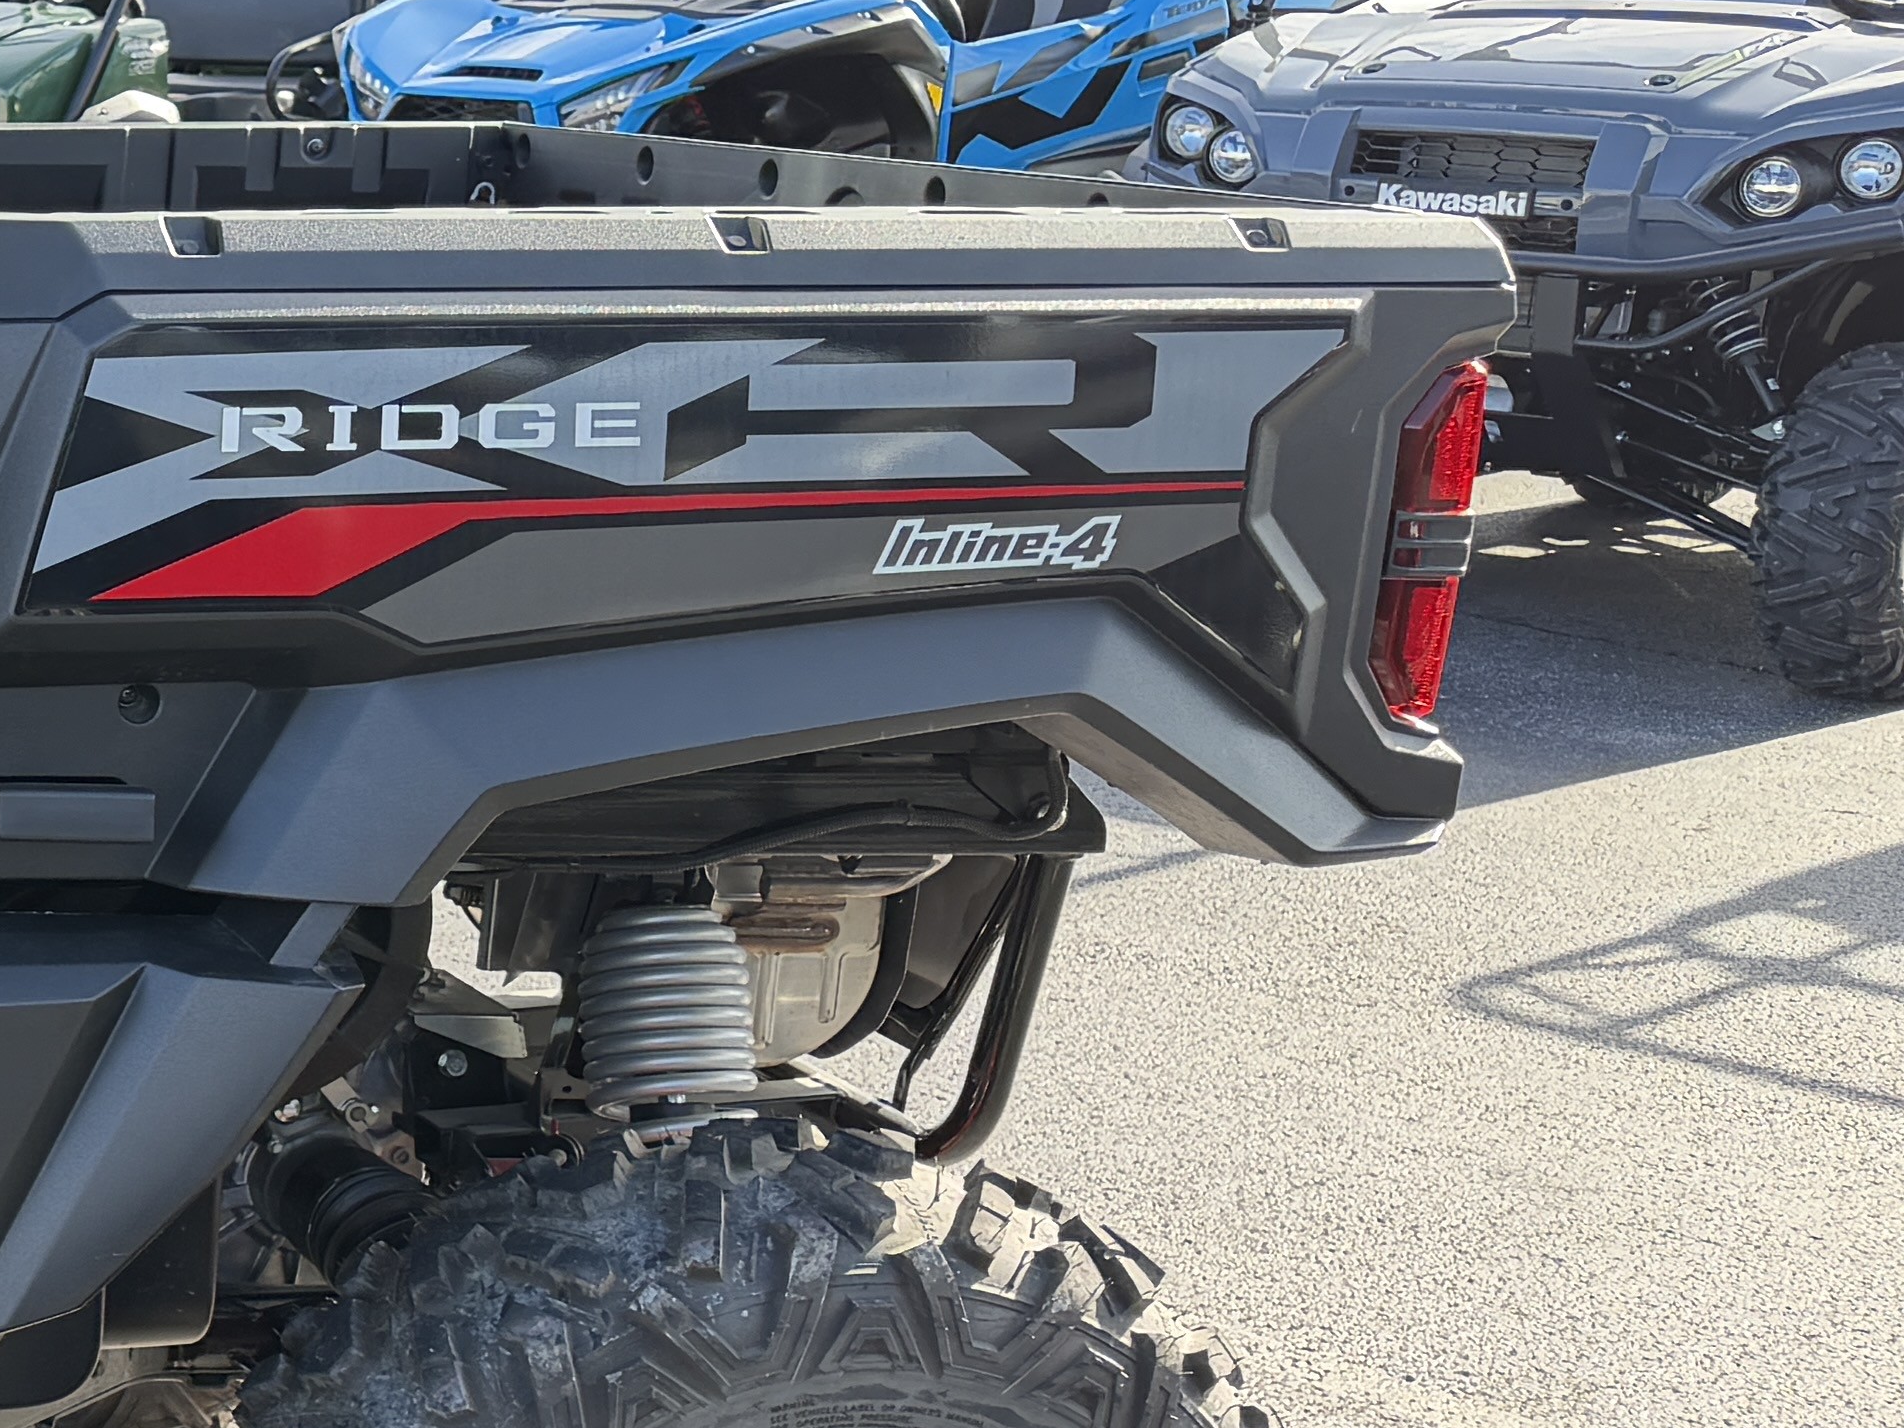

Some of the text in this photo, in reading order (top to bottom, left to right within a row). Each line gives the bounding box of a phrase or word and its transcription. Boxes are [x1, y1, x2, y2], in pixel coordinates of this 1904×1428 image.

[1377, 183, 1528, 217] Kawasaki
[221, 401, 642, 453] RIDGE
[872, 515, 1122, 575] Inline-4
